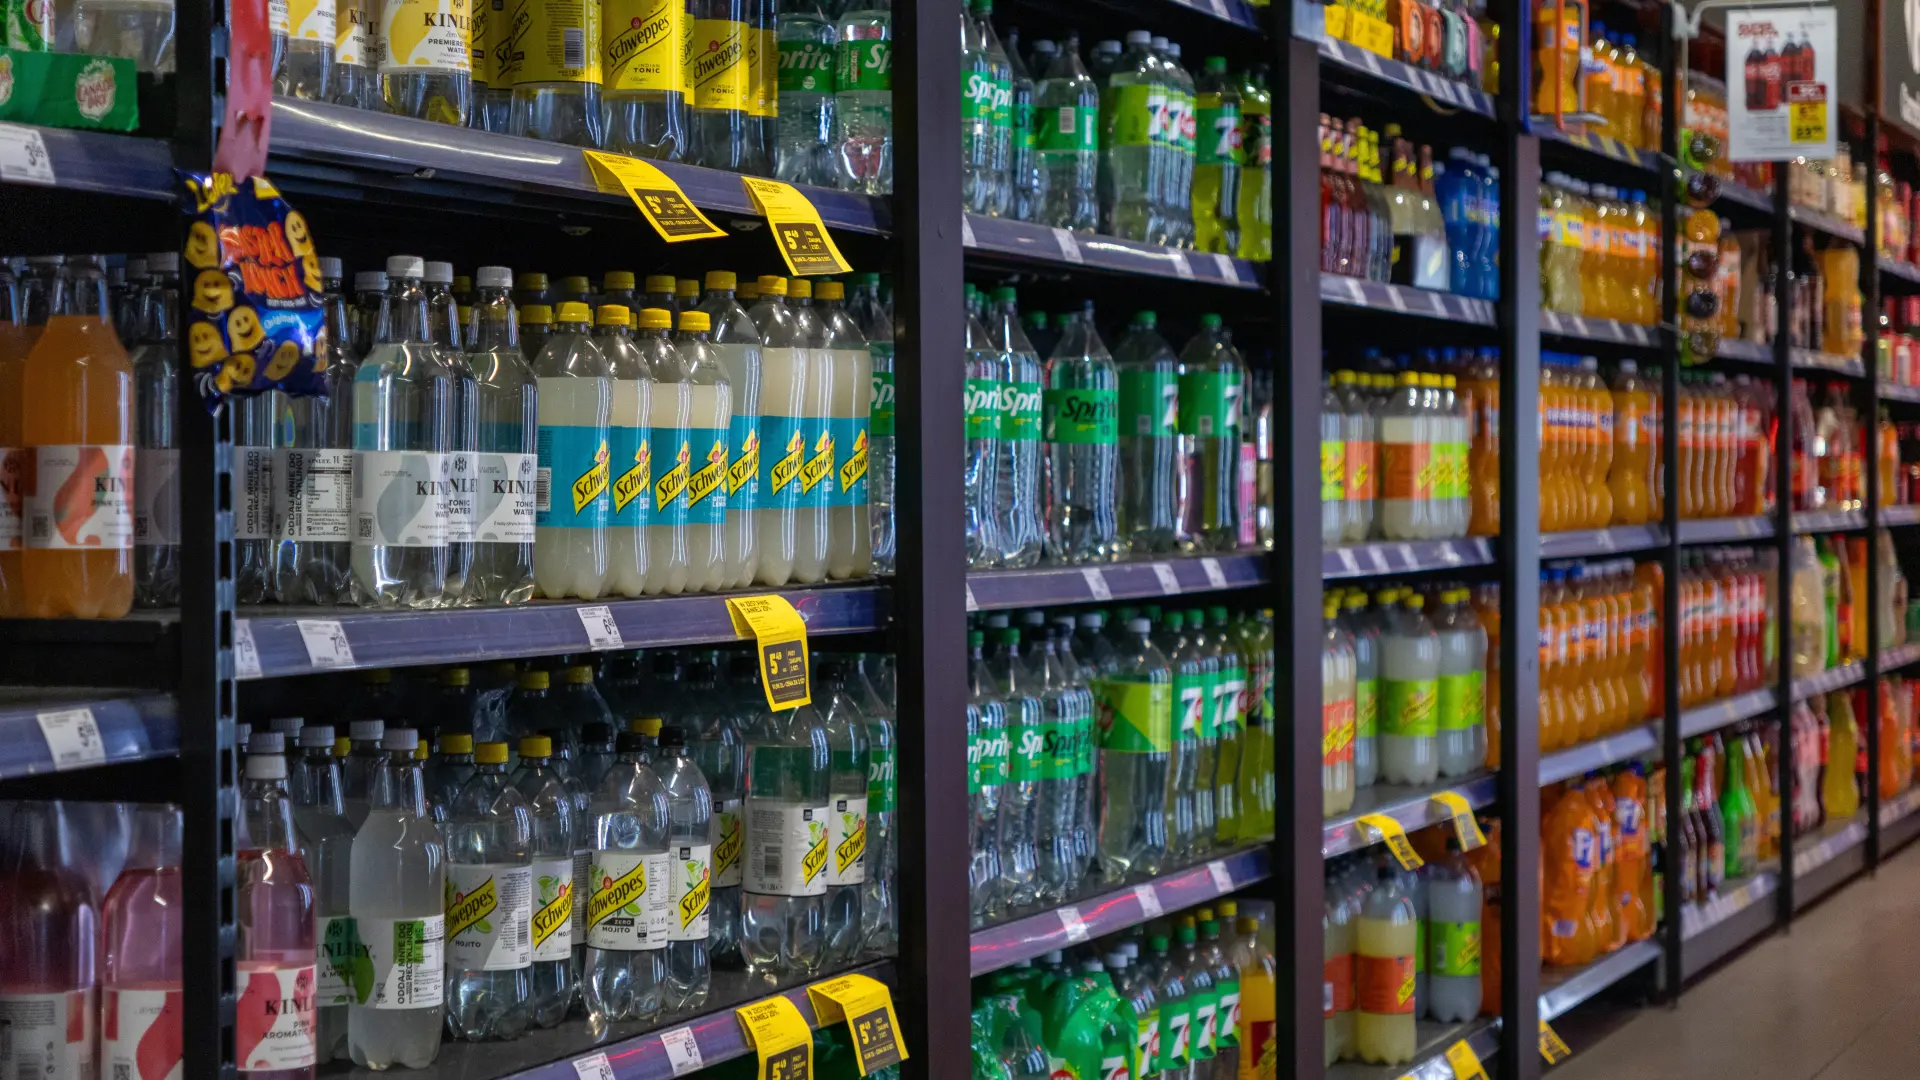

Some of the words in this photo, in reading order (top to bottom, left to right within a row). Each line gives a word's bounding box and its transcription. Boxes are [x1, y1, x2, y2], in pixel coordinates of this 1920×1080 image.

[608, 14, 670, 68] Schweppes
[288, 470, 296, 497] MNIE
[588, 872, 643, 922] Schweppes
[455, 940, 482, 948] MOJITO
[602, 926, 631, 934] MOJITO
[397, 969, 405, 1004] ODDAJ
